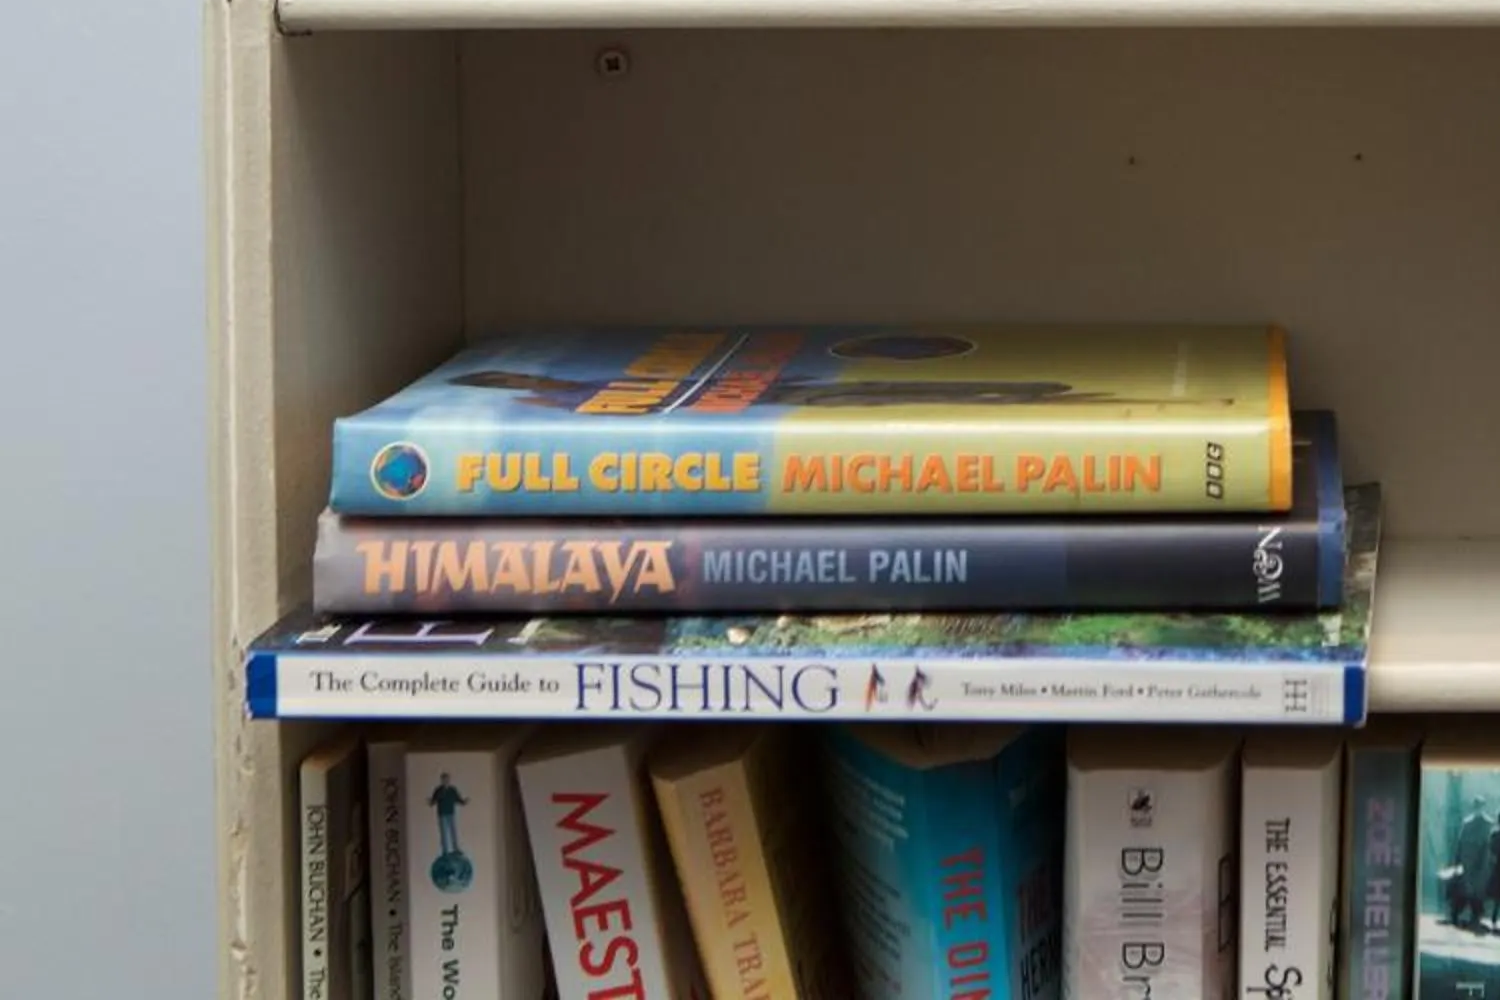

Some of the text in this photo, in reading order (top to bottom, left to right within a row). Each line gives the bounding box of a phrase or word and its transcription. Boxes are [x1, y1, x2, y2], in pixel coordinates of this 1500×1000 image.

[455, 452, 1163, 494] FULL CIRCLE MICHAEL PALIN
[355, 539, 676, 602] HIMALAYA
[703, 549, 968, 584] MICHAEL PALIN
[310, 661, 840, 714] The Complete Guide to FISHING
[305, 804, 328, 1000] JOHN BUCHAN The
[700, 786, 772, 1000] BARBARA TRA
[939, 845, 989, 930] THE
[1121, 847, 1164, 918] Bill
[1264, 817, 1291, 952] THE ESSENTIAL
[388, 923, 404, 952] The
[440, 904, 459, 950] The
